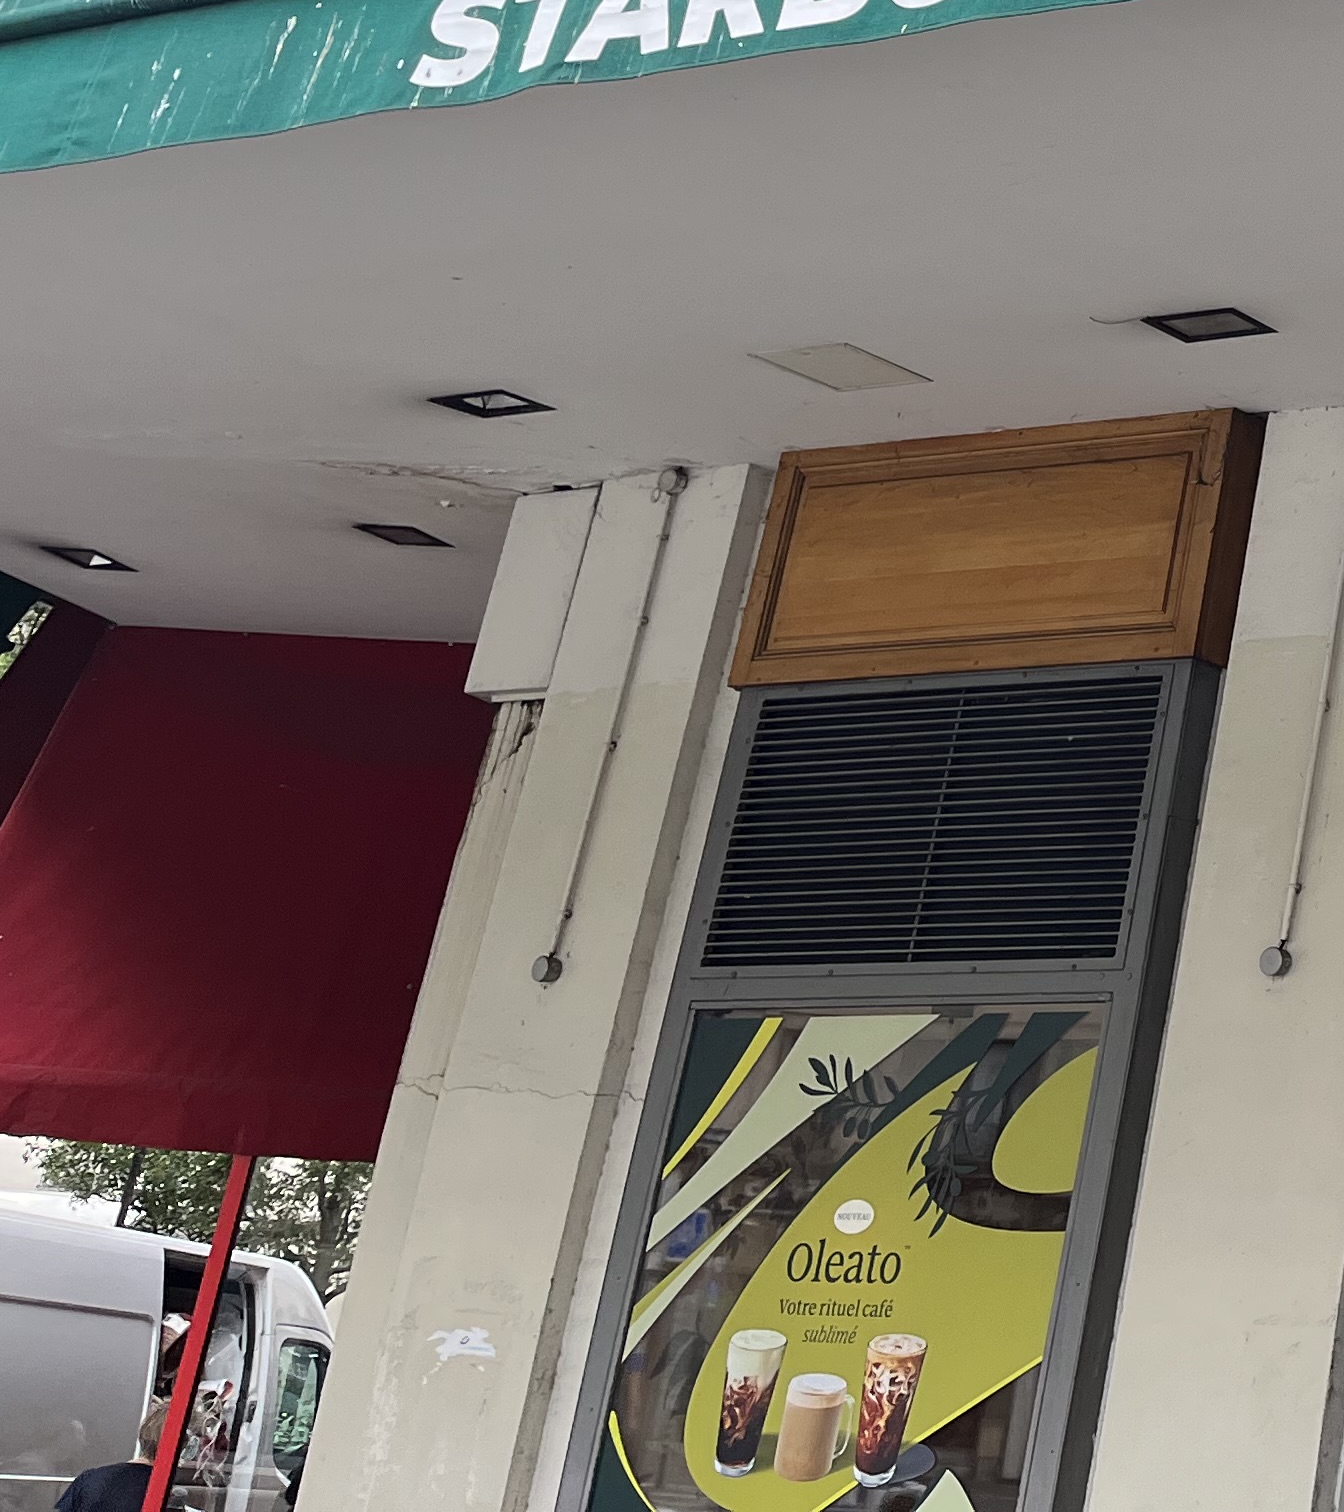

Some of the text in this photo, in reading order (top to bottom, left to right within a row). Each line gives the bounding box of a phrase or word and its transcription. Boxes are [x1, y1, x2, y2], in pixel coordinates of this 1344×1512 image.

[836, 1212, 871, 1221] NOUVEAU
[787, 1238, 901, 1284] Oleato
[779, 1298, 894, 1318] Votre rituel café
[802, 1325, 859, 1344] sublimé
